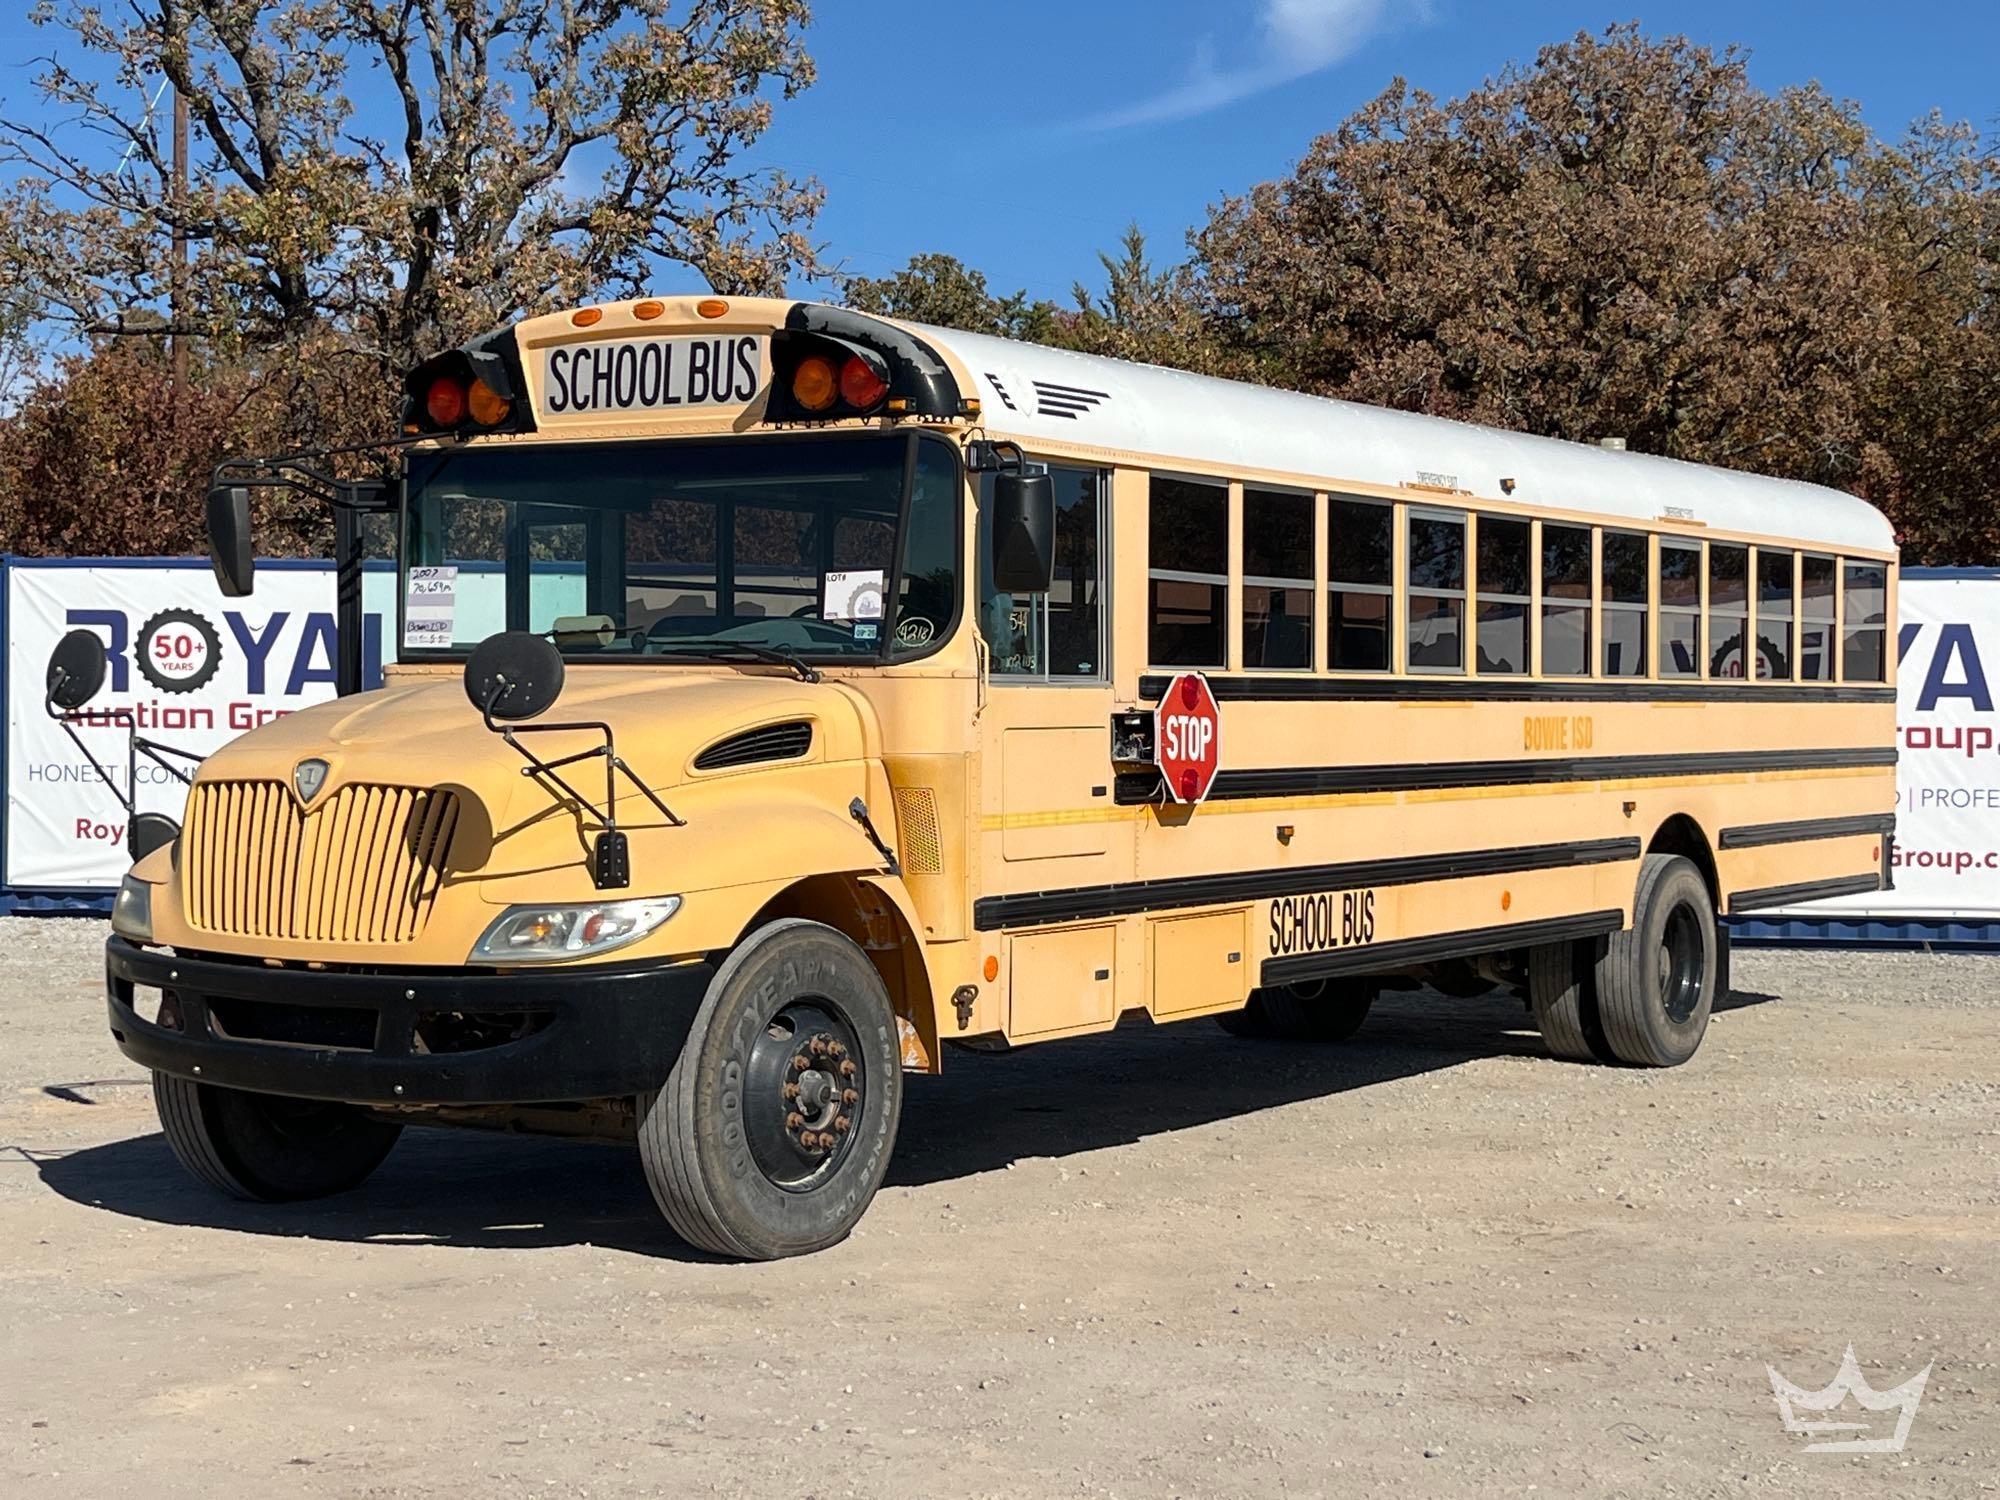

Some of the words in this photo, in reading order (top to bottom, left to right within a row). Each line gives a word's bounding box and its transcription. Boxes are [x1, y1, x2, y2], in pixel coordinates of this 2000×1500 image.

[549, 342, 682, 413] SCHOOL
[688, 336, 759, 403] BUS
[826, 573, 847, 582] LOT#
[154, 635, 205, 659] 50+
[899, 624, 929, 641] 4218
[161, 662, 194, 671] YEARS
[1898, 623, 1994, 711] A
[1166, 715, 1212, 762] STOP
[1524, 716, 1568, 751] BOWIE
[1571, 715, 1593, 749] ISD
[1897, 727, 1992, 758] oup
[29, 764, 119, 784] HONEST
[1269, 894, 1338, 956] SCHOOL
[1342, 889, 1375, 944] BUS
